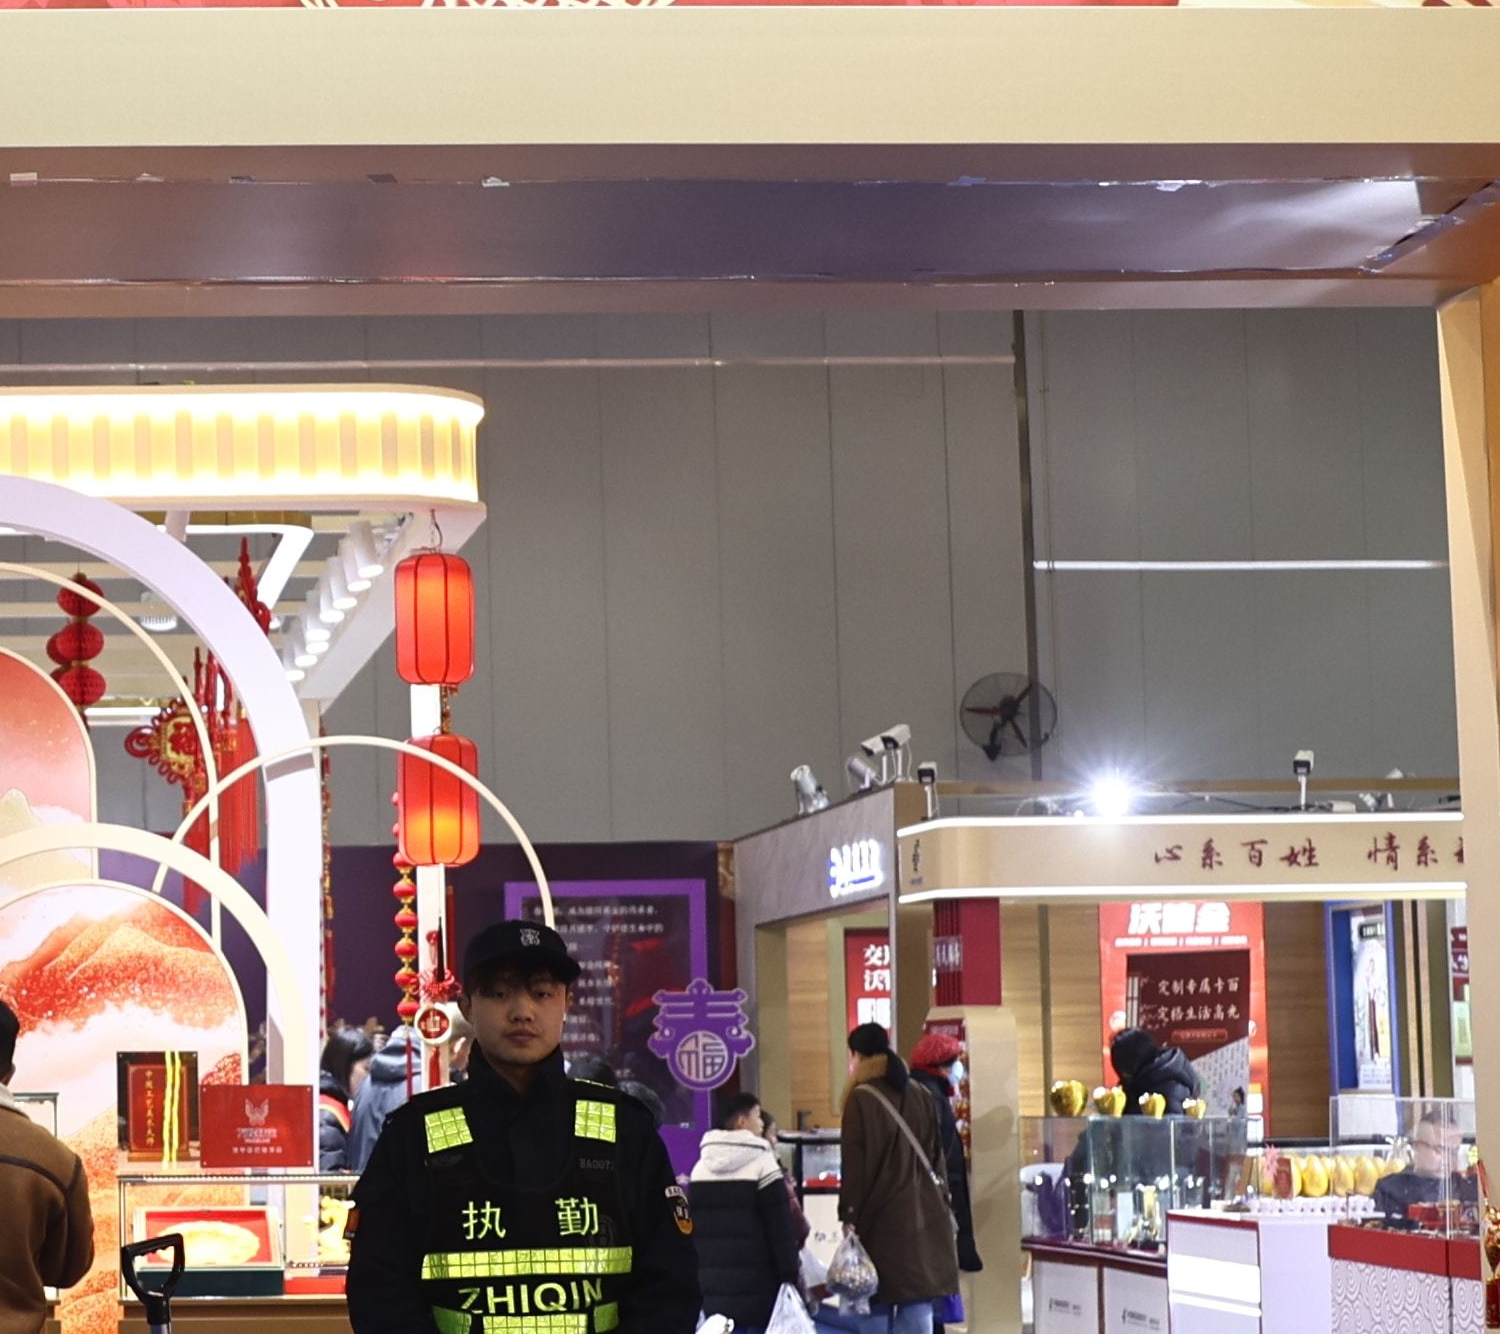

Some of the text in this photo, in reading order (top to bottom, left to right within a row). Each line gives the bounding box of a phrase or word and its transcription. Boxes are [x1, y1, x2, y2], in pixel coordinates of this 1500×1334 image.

[1154, 838, 1320, 870] 心系百姓
[462, 1196, 599, 1240] 执 勤
[458, 1278, 603, 1314] ZHIQIN
